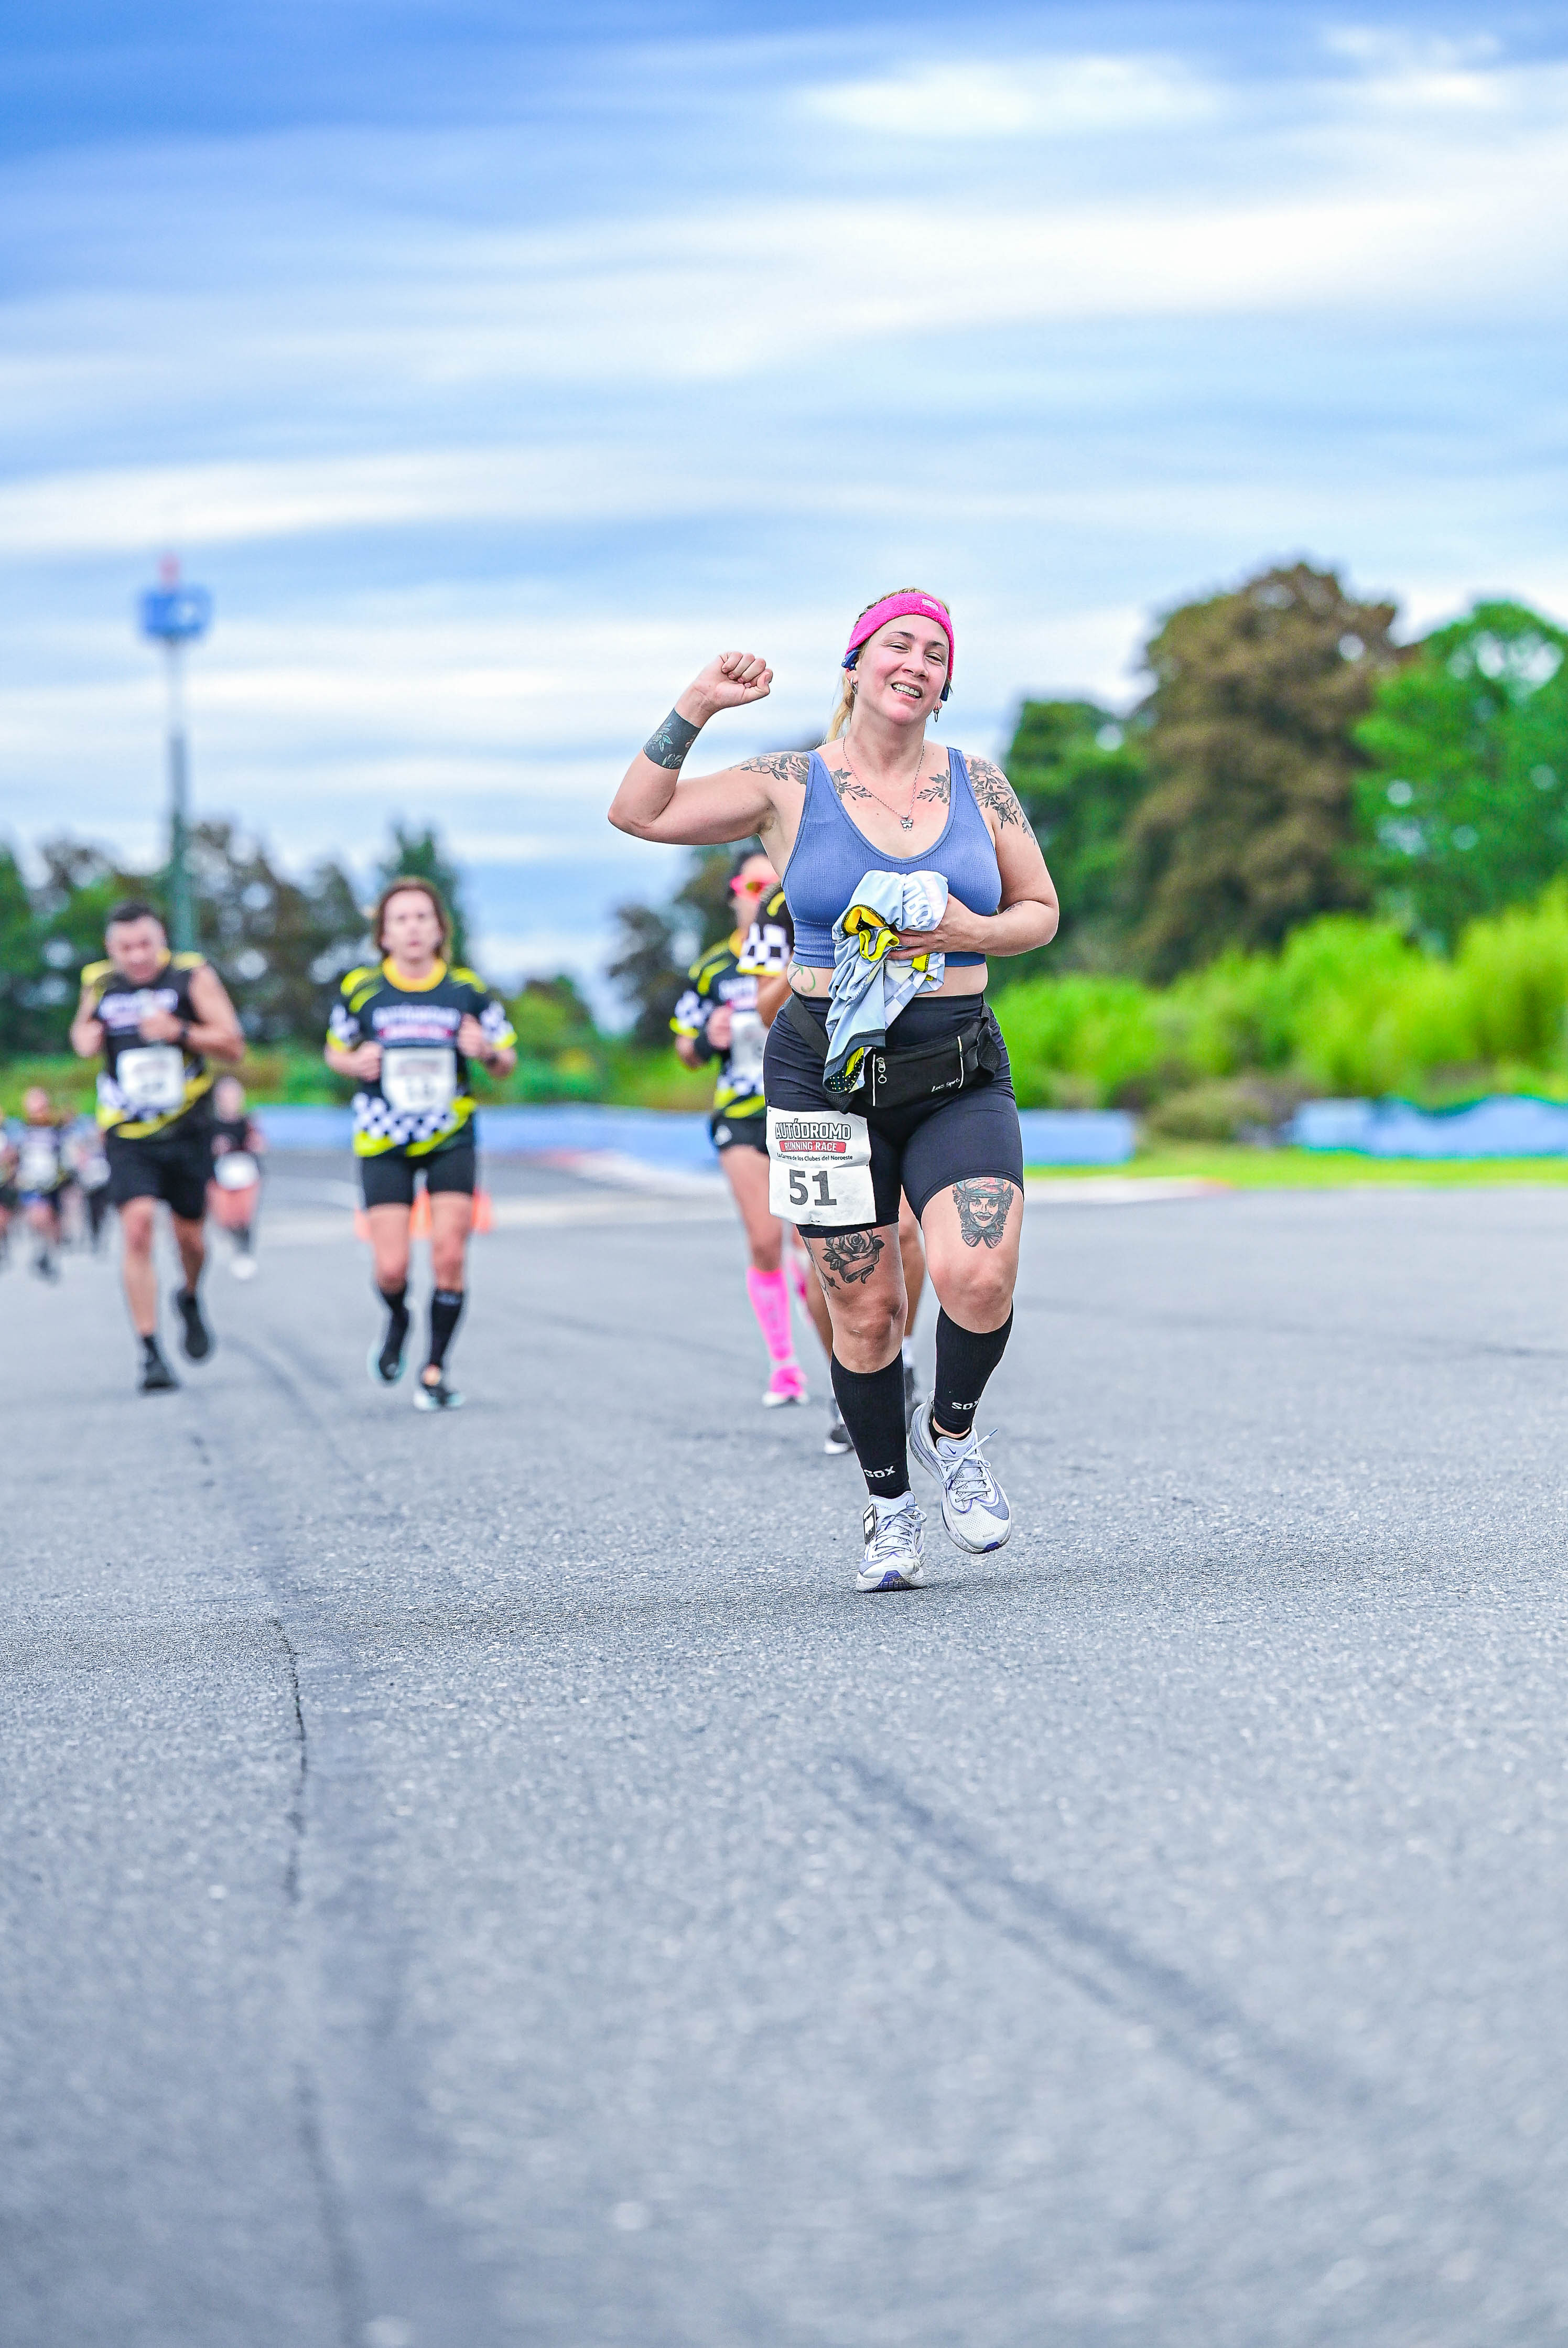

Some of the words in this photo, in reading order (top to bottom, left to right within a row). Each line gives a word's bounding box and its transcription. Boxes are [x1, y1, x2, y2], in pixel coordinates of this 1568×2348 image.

[775, 1118, 851, 1140] AUTÓDROMO
[784, 1141, 813, 1151] RUNNING
[815, 1142, 837, 1151] RACE
[789, 1169, 837, 1205] 51
